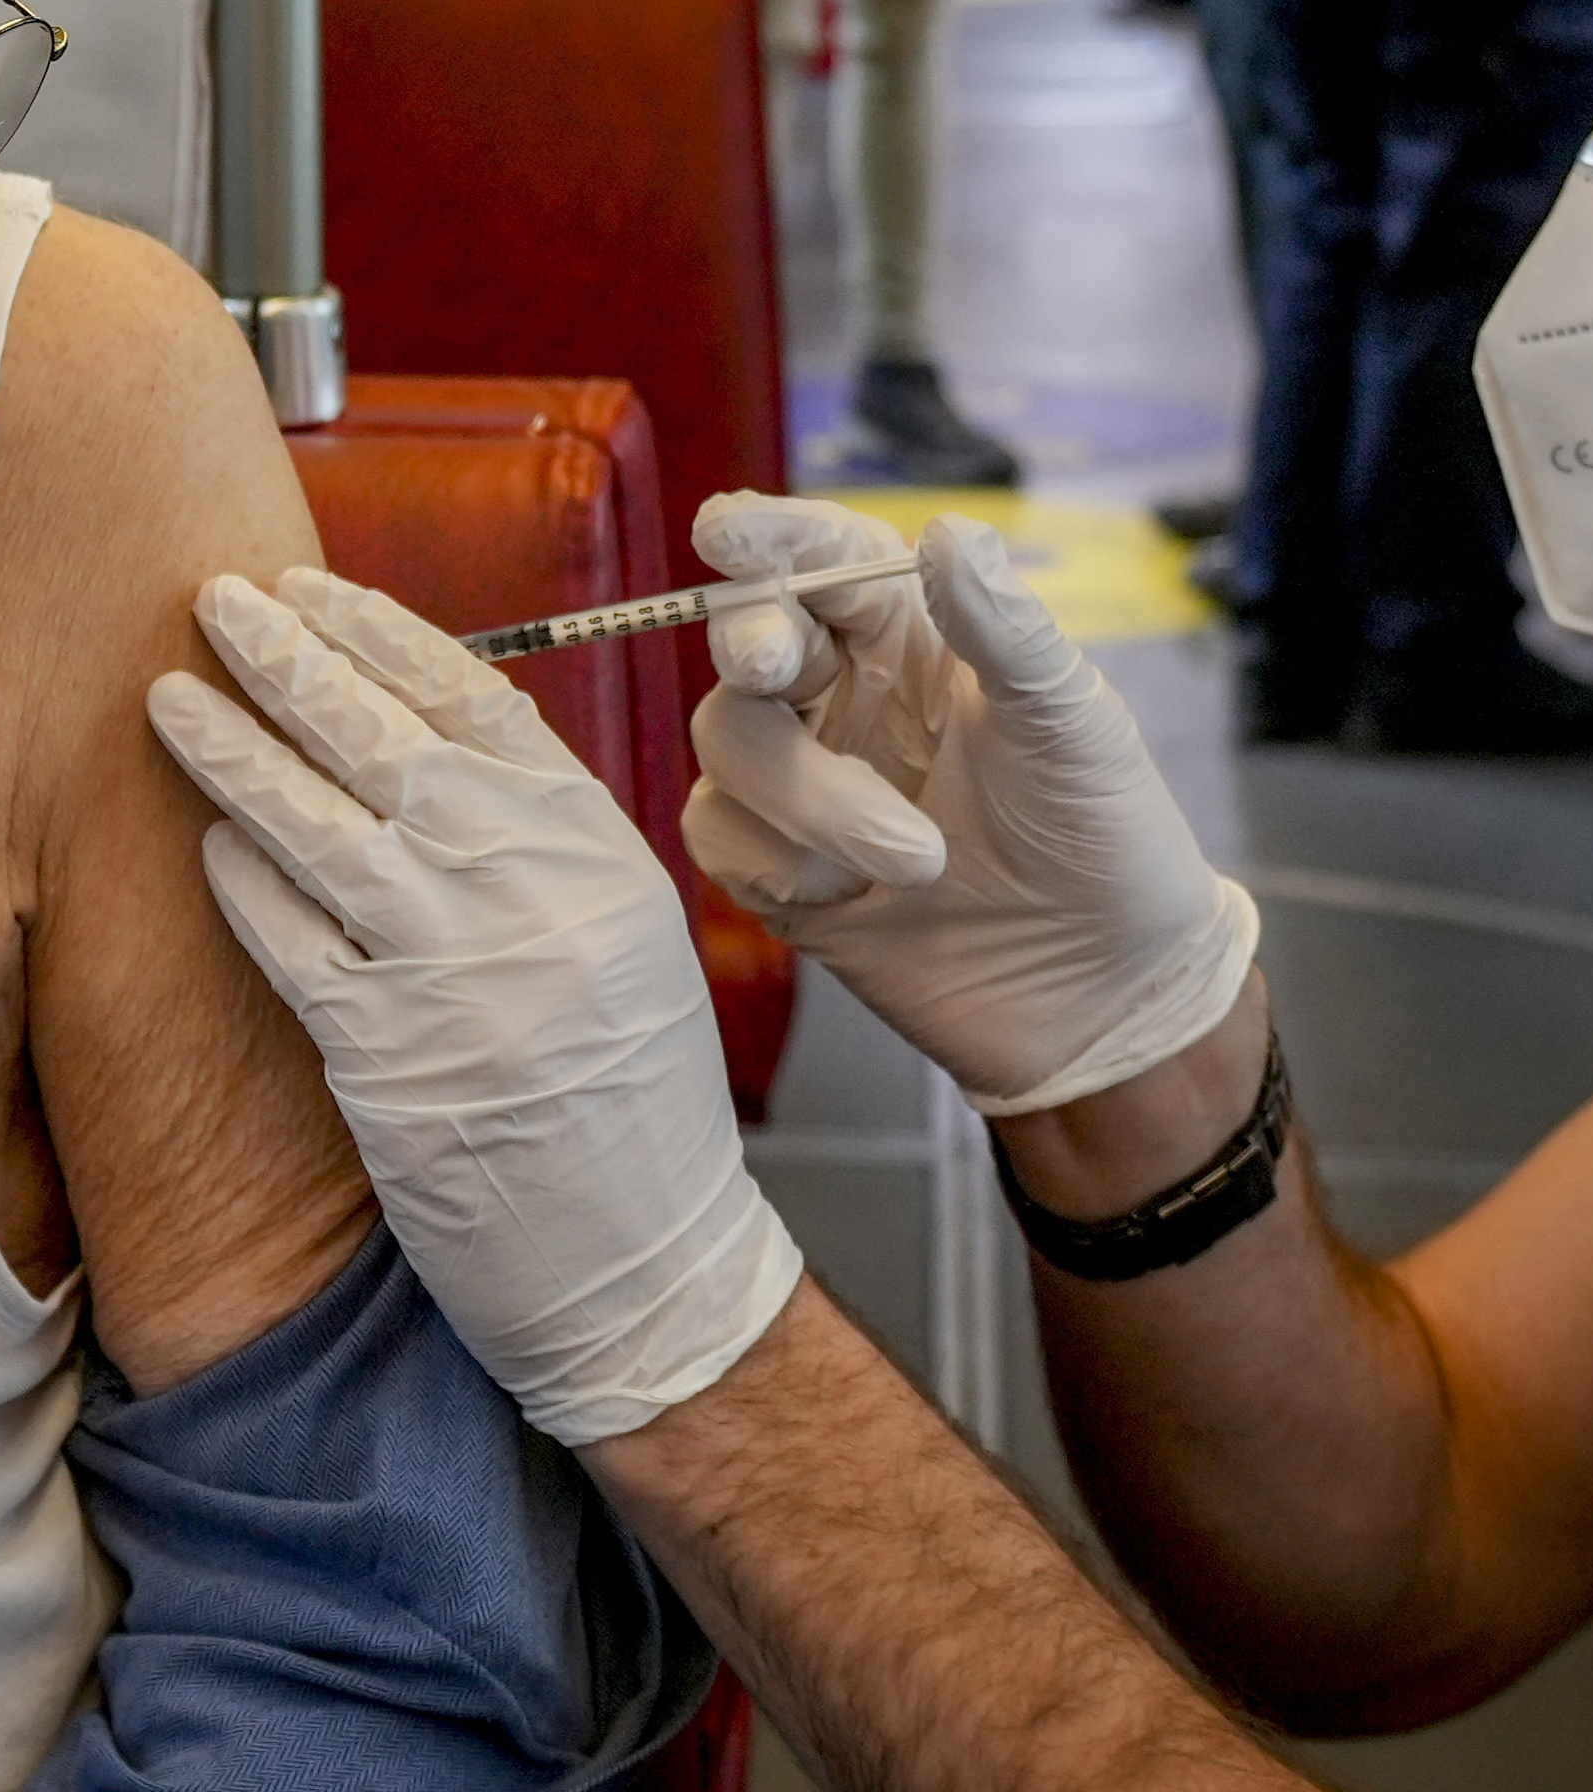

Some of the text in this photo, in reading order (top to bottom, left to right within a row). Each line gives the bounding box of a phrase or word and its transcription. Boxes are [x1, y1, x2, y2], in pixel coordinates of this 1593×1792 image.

[613, 612, 632, 632] 0.7
[639, 606, 657, 627] 0.8
[664, 601, 682, 623] 0.9
[563, 621, 581, 643] 0.5
[588, 616, 606, 637] 0.6
